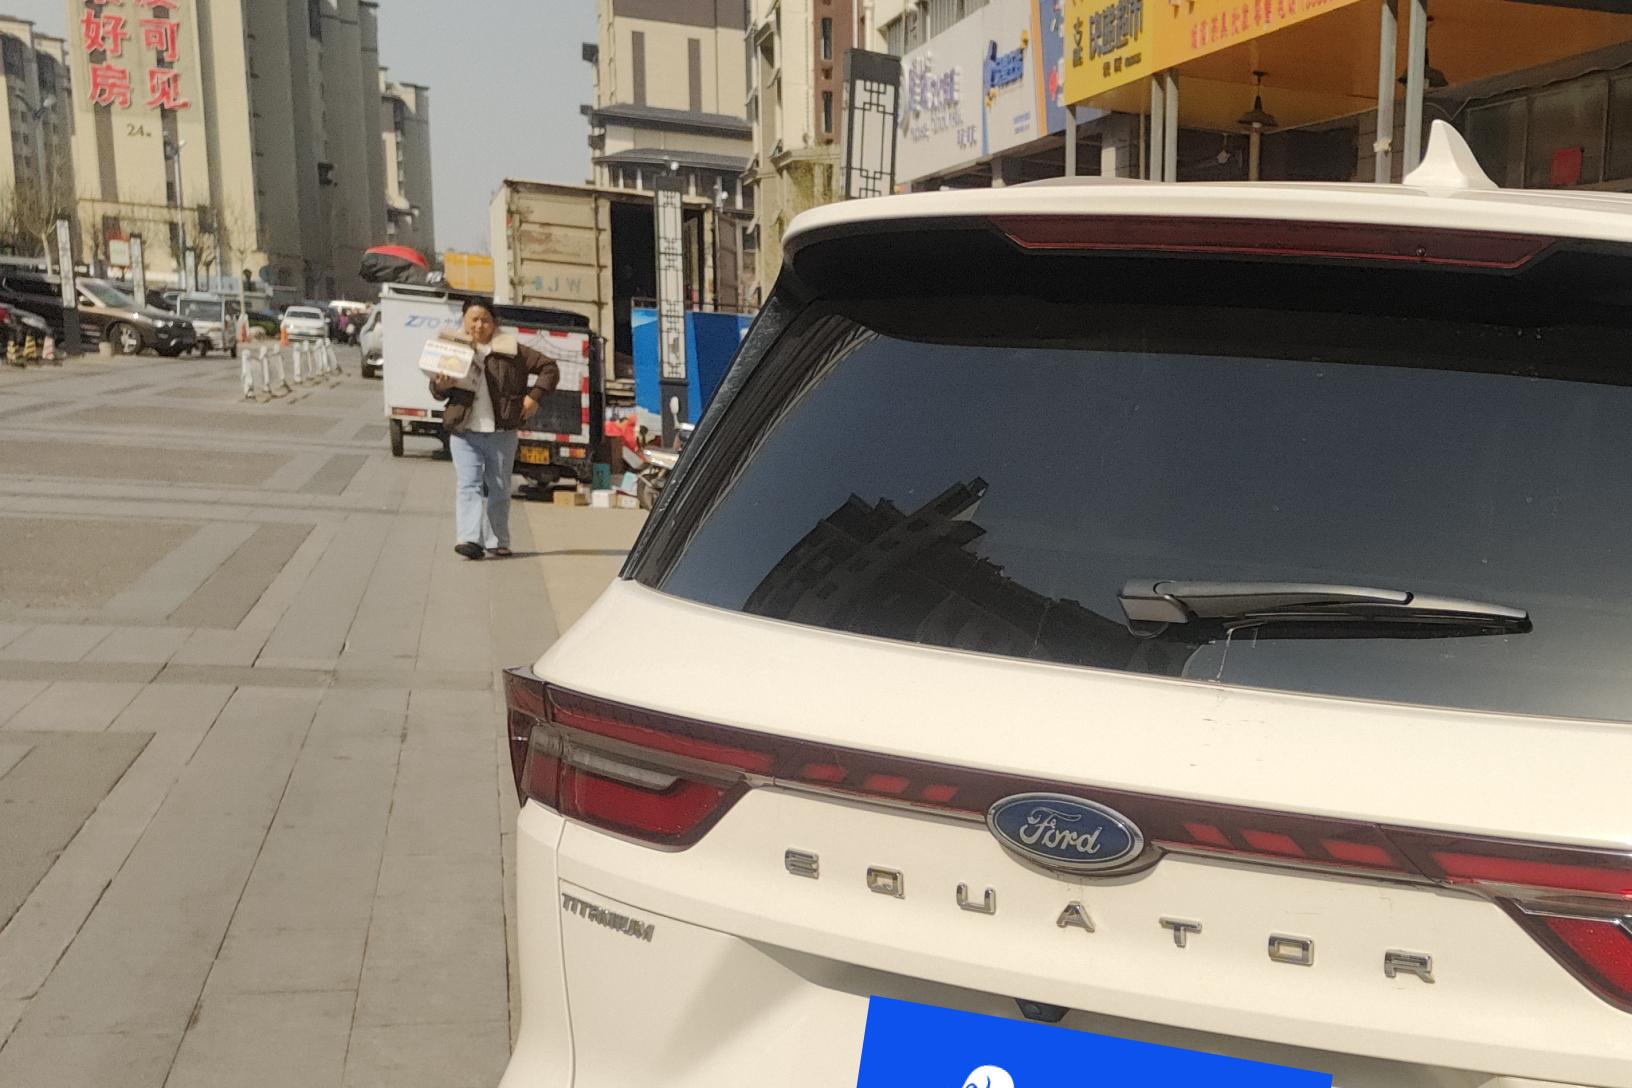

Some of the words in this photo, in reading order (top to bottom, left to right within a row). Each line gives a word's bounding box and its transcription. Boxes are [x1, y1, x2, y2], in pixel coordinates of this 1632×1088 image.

[81, 0, 131, 108] 好房
[136, 0, 190, 110] 可见
[1017, 806, 1101, 856] Ford
[784, 847, 1436, 984] EQUATOR
